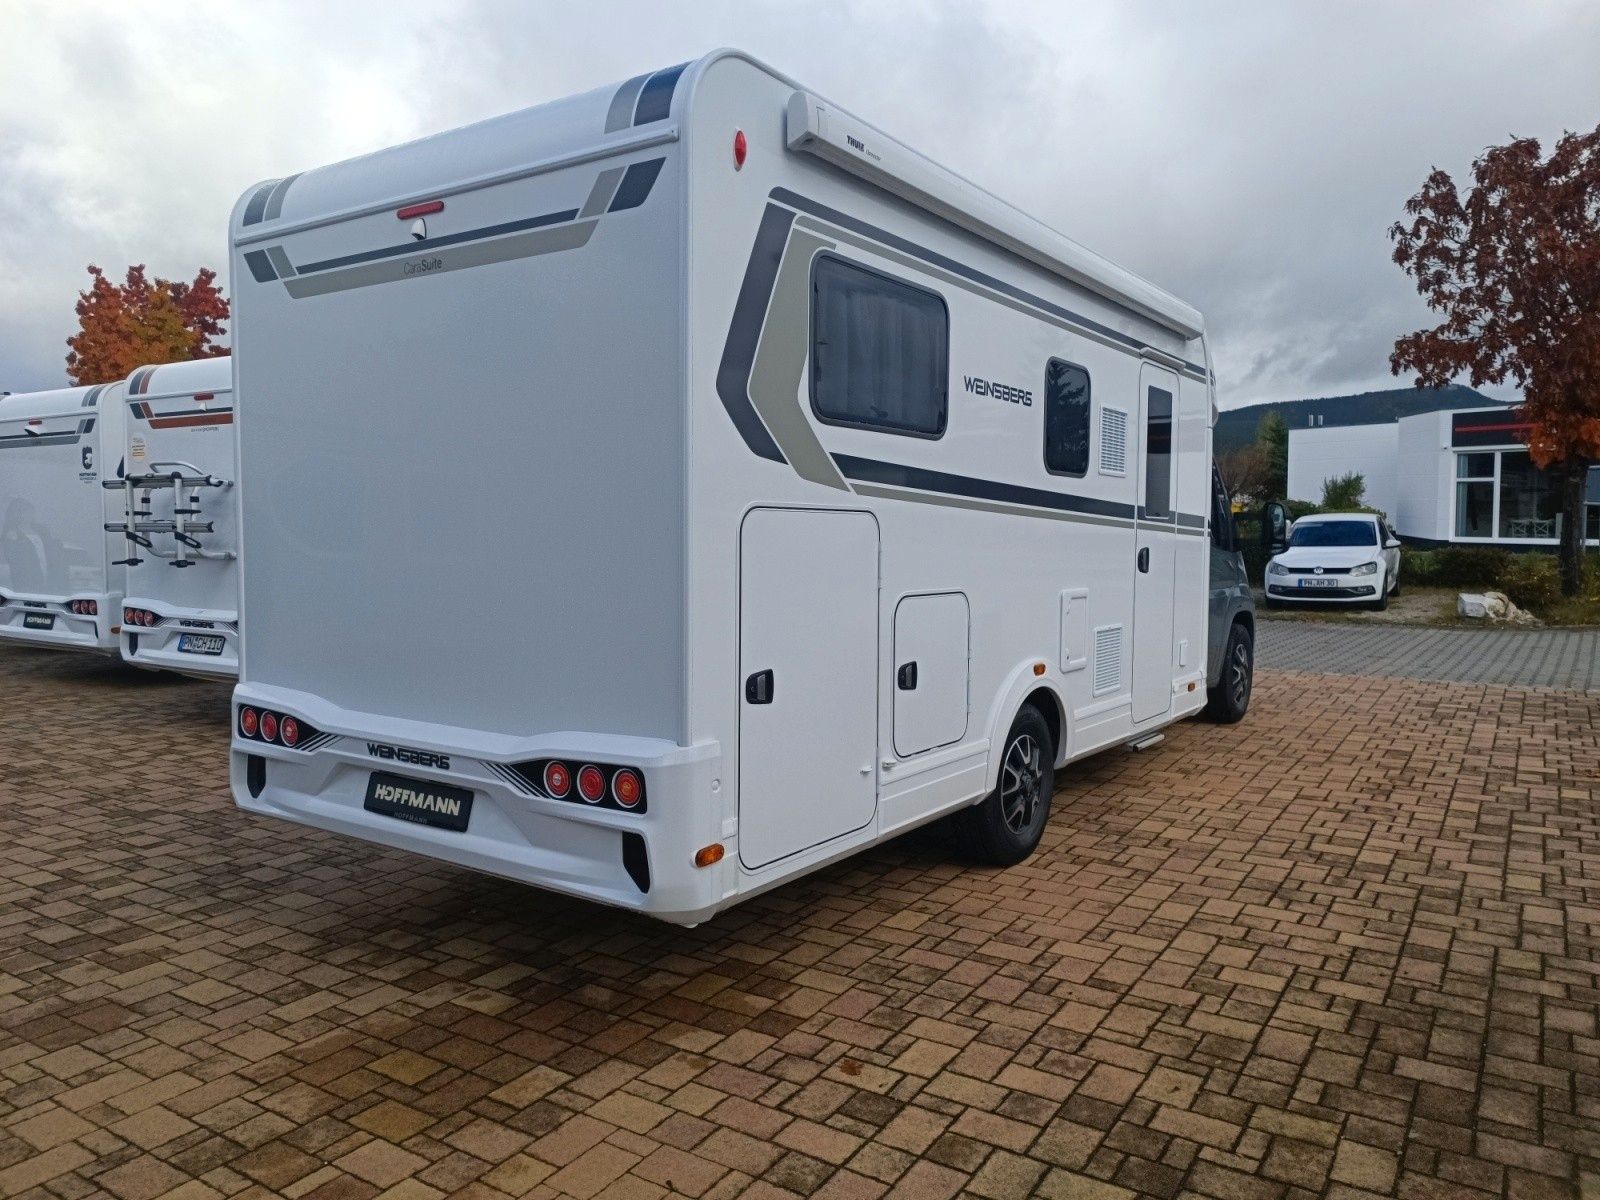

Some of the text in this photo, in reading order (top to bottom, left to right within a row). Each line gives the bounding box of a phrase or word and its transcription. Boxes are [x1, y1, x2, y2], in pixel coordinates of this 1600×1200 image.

[403, 259, 442, 274] CaraSuite
[964, 375, 1033, 407] WEINSBERG
[367, 743, 450, 770] WEINSBERG
[375, 784, 461, 816] HOFFMANN
